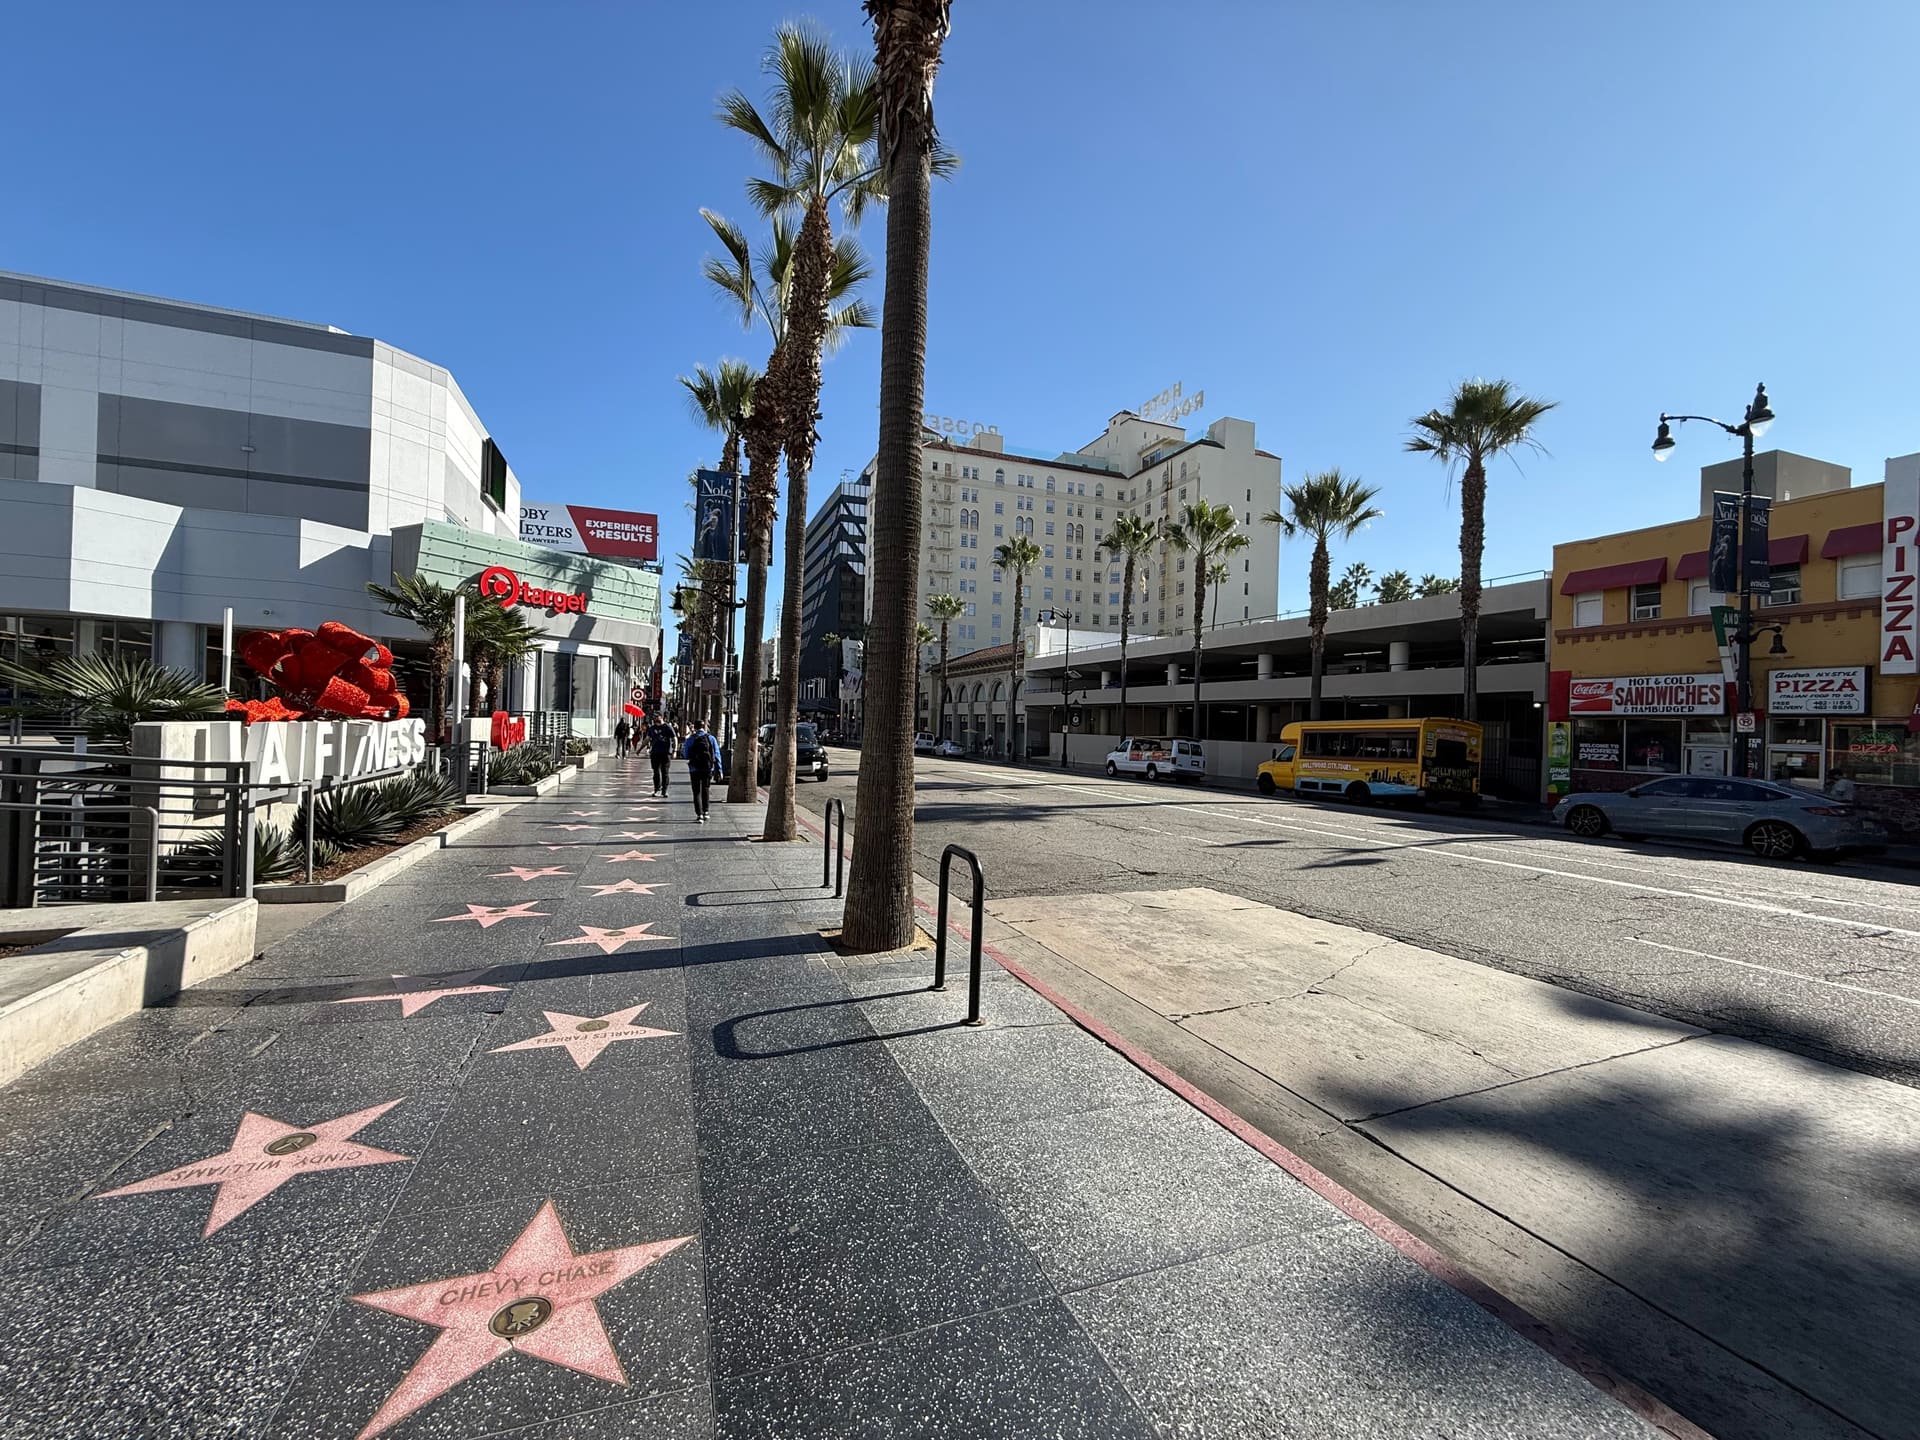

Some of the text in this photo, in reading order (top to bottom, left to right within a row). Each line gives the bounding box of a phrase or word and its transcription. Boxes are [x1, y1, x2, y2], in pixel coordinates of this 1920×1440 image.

[585, 519, 653, 534] EXPERIENCE
[589, 530, 653, 543] +RESULTS
[1882, 516, 1916, 662] PIZZA
[522, 581, 587, 614] target
[1628, 676, 1695, 686] HOT & COLD
[1775, 679, 1859, 693] PIZZA
[1614, 684, 1721, 706] SANDWICHES
[1850, 744, 1898, 753] PIZZA
[1578, 753, 1620, 762] PIZZA
[592, 1028, 647, 1042] CHARLES
[171, 1150, 363, 1183] CINDY WILLIAMS
[439, 1259, 615, 1306] CHEVY CHASE
